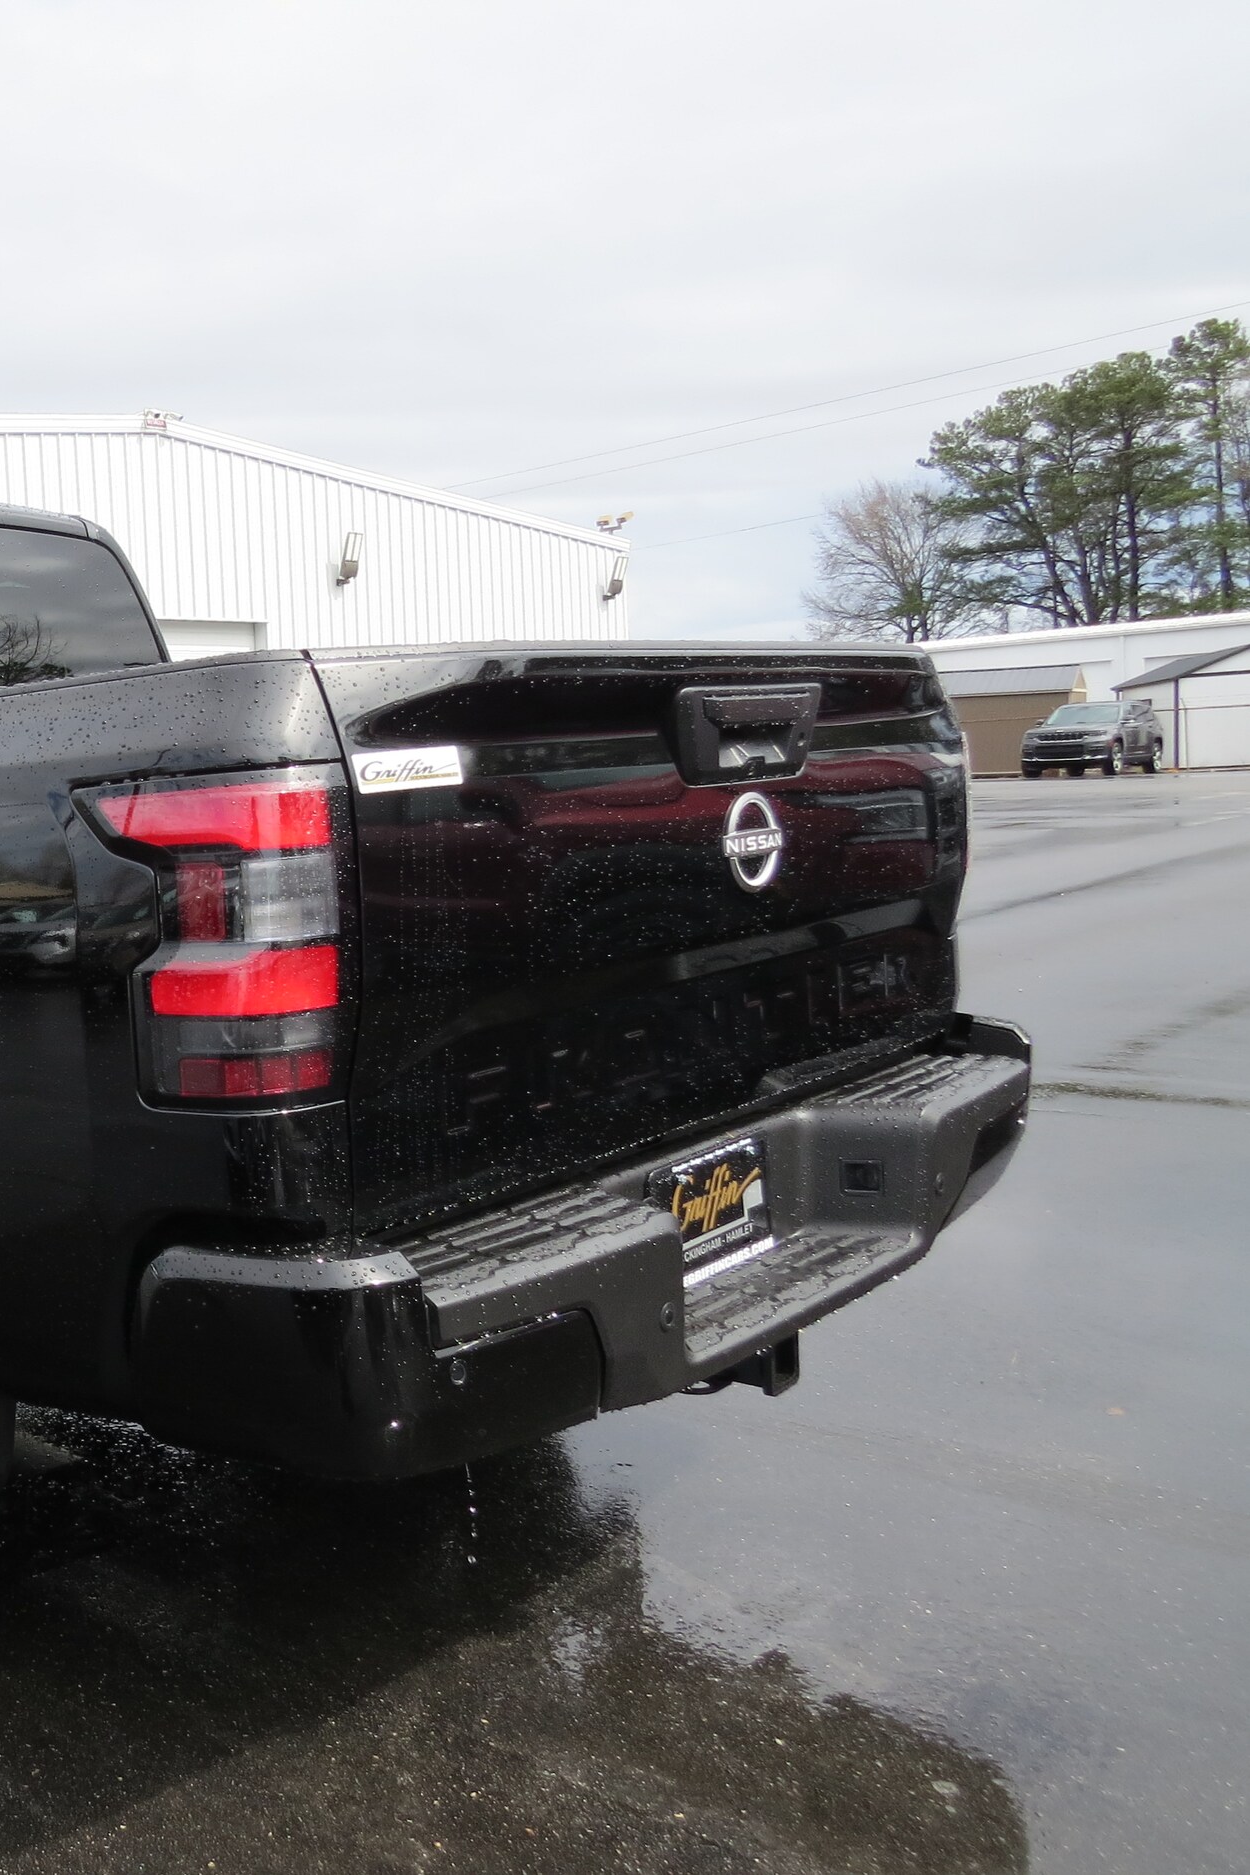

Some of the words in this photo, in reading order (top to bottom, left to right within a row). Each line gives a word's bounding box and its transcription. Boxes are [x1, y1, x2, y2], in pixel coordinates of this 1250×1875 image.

[360, 759, 457, 782] Griffin
[726, 832, 782, 853] NISSAN
[672, 1163, 761, 1233] Griffin
[683, 1236, 722, 1262] CKINGHAM
[725, 1223, 754, 1244] HAMLET
[683, 1236, 774, 1287] EGRIFFINCARS.COM
